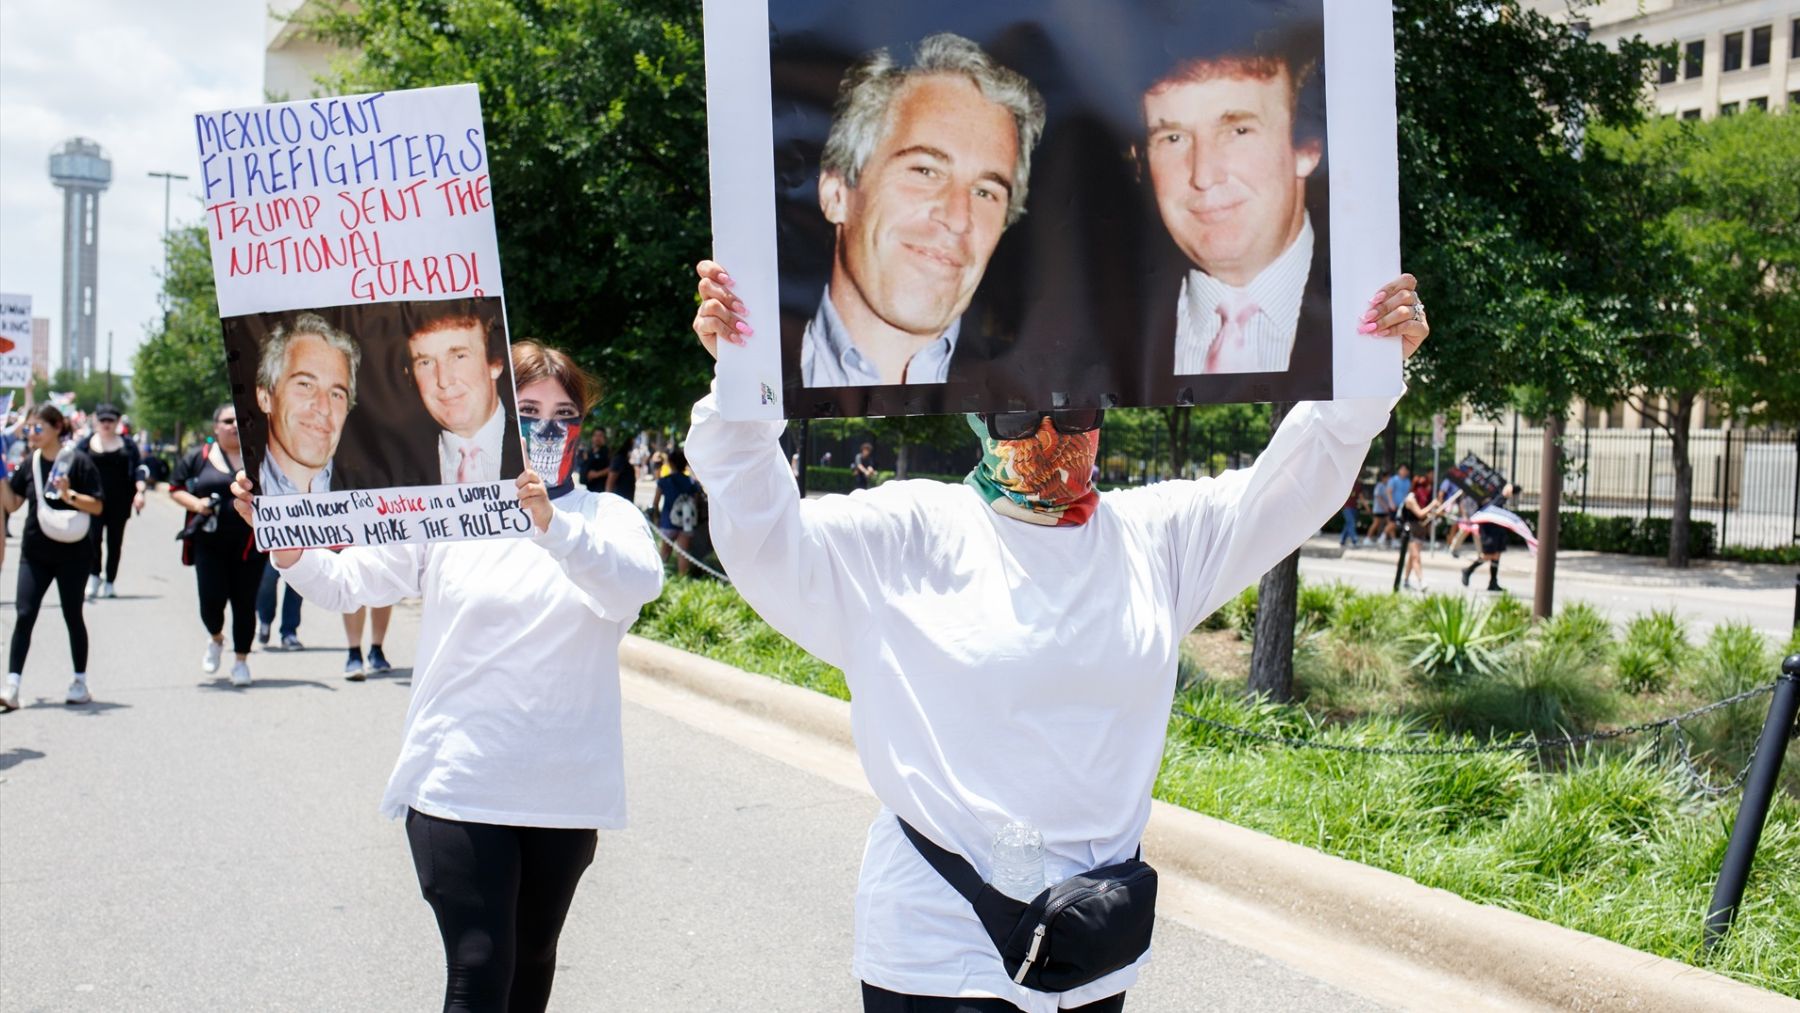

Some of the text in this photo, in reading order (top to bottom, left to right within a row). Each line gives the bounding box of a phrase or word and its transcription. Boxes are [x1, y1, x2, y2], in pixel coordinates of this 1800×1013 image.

[195, 92, 385, 155] MEXICO SENT
[202, 128, 482, 199] FIREFIGHTERS
[207, 174, 491, 240] TRUMP SENT THE
[230, 231, 399, 277] NATIONAL
[351, 252, 485, 300] GUARD!
[256, 508, 532, 549] CRIMINALS MAKE THE RULES
[285, 499, 315, 518] will
[316, 500, 349, 518] never
[429, 496, 443, 510] in
[446, 497, 456, 508] a
